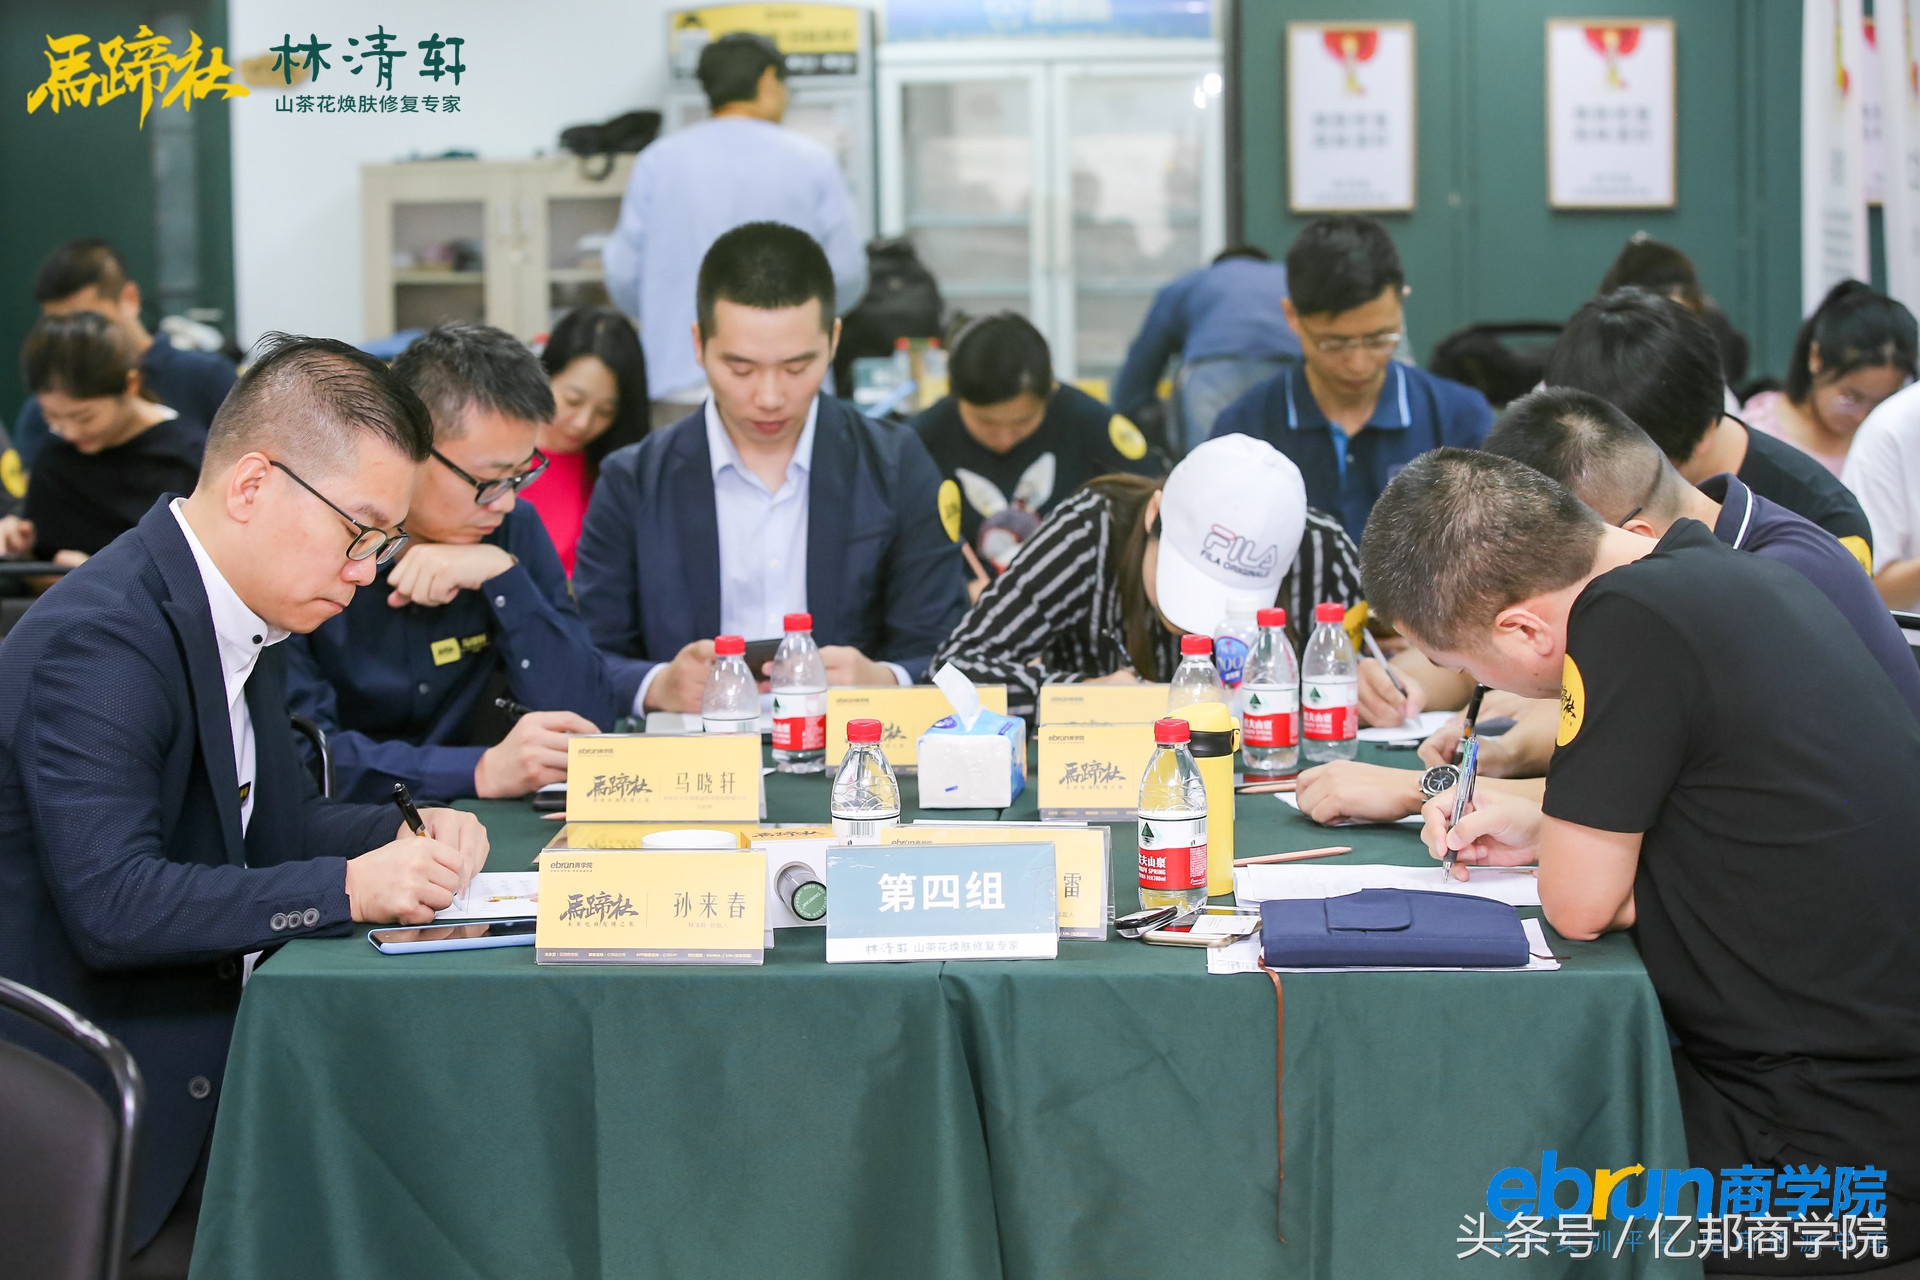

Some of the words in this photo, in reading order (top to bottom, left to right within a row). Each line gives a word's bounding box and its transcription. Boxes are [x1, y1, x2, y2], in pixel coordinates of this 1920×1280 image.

[1204, 523, 1278, 570] FILA
[675, 771, 736, 794] 马晓轩
[877, 870, 1006, 914] 第四组
[1063, 872, 1082, 899] 雷
[673, 891, 747, 919] 孙来春
[913, 940, 1020, 954] 山茶花焕肤修复专家
